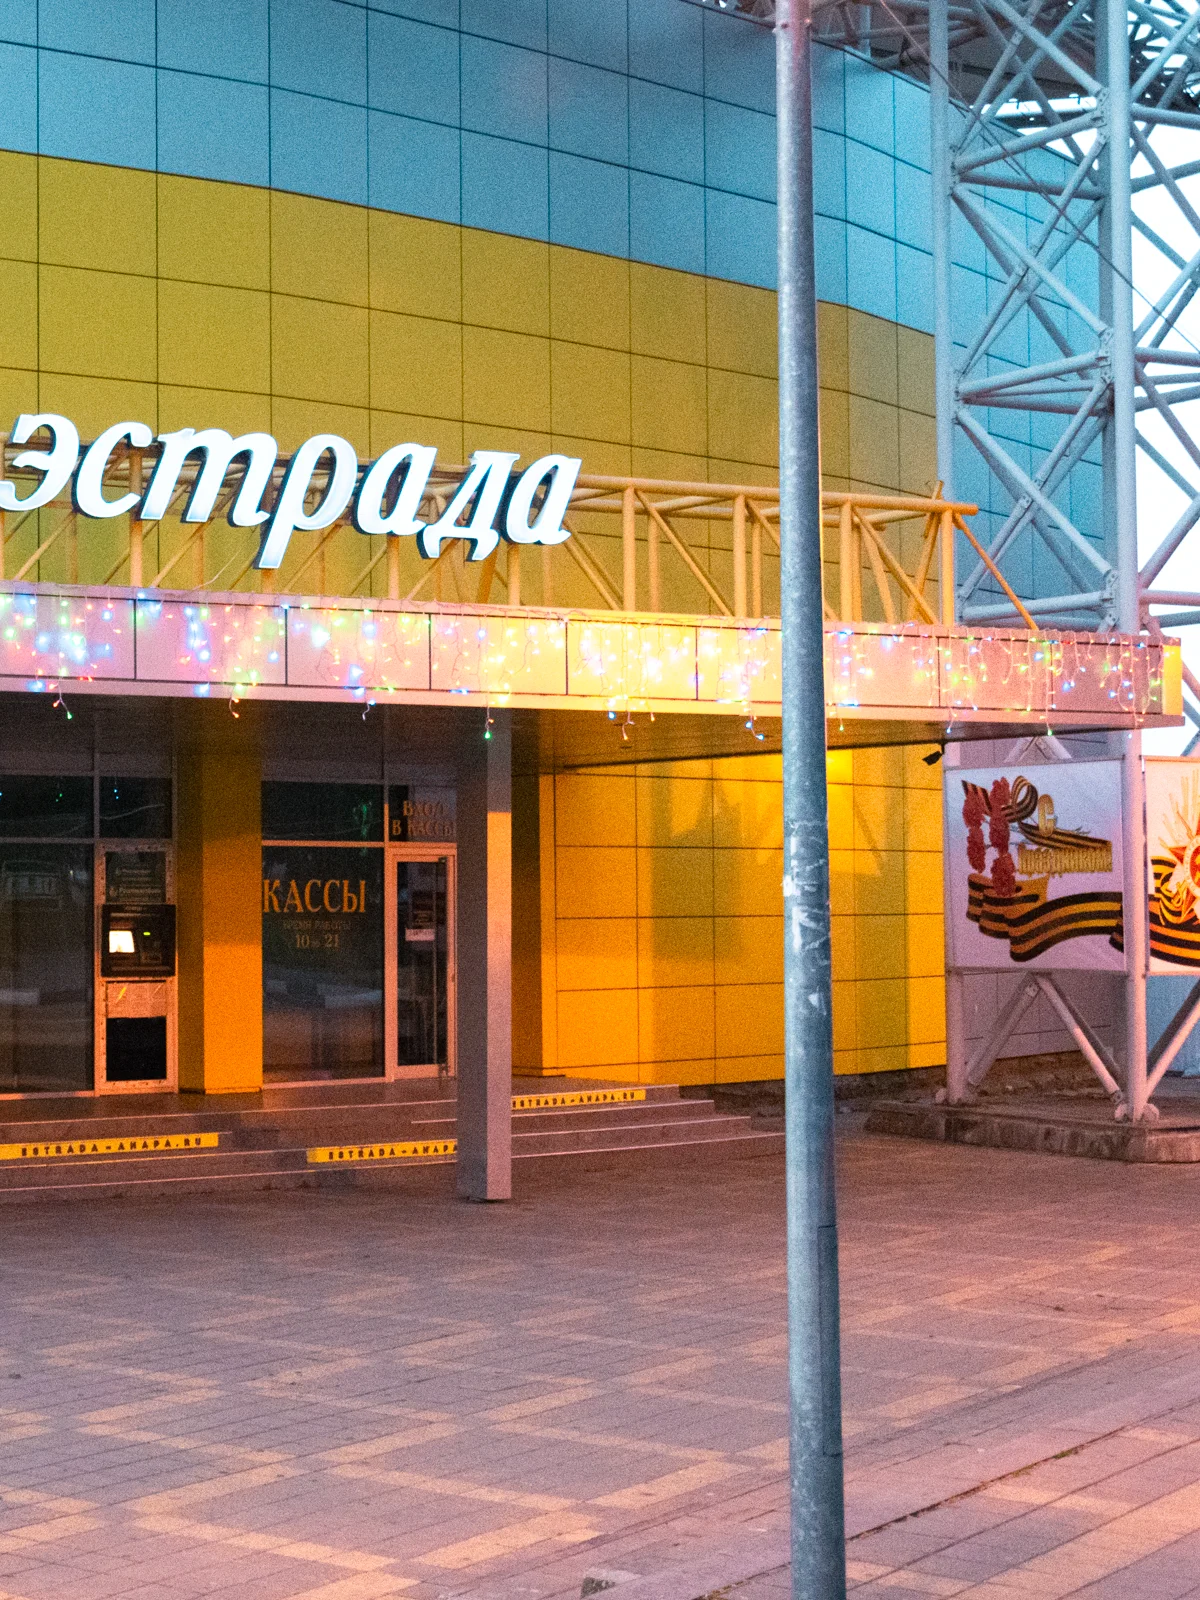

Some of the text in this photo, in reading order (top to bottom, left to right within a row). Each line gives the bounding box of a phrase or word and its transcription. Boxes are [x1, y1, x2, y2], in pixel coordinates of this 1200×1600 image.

[263, 879, 366, 913] КАССЫ
[296, 934, 310, 948] 10
[324, 933, 340, 948] 21
